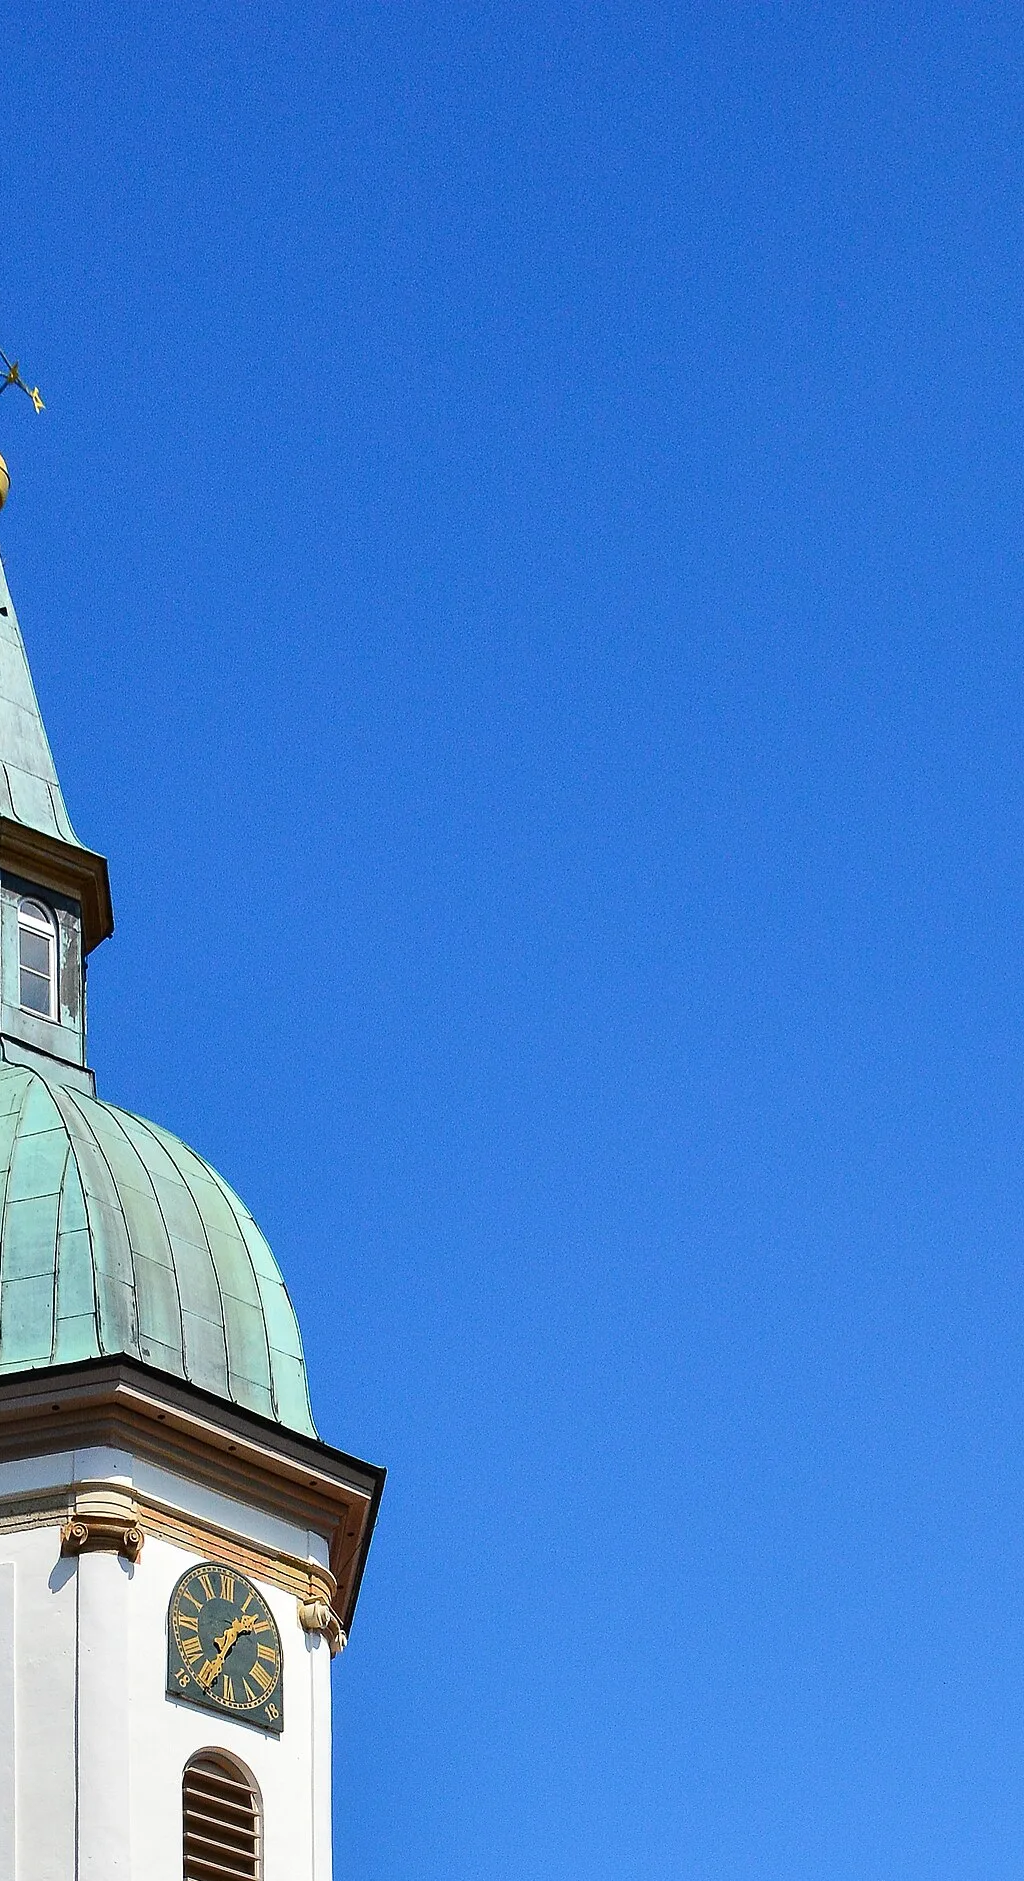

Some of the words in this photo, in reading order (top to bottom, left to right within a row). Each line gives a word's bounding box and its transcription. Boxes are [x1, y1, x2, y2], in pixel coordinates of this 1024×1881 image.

[199, 1573, 216, 1601] XI
[220, 1573, 235, 1603] XII
[183, 1588, 203, 1612] X
[241, 1592, 254, 1613] I
[178, 1611, 199, 1633] IX
[182, 1636, 204, 1664] VIII
[257, 1642, 276, 1664] III
[174, 1667, 191, 1688] 18
[222, 1674, 235, 1702] VI
[249, 1660, 273, 1691] IIII
[242, 1676, 257, 1702] V
[264, 1703, 279, 1723] 18
